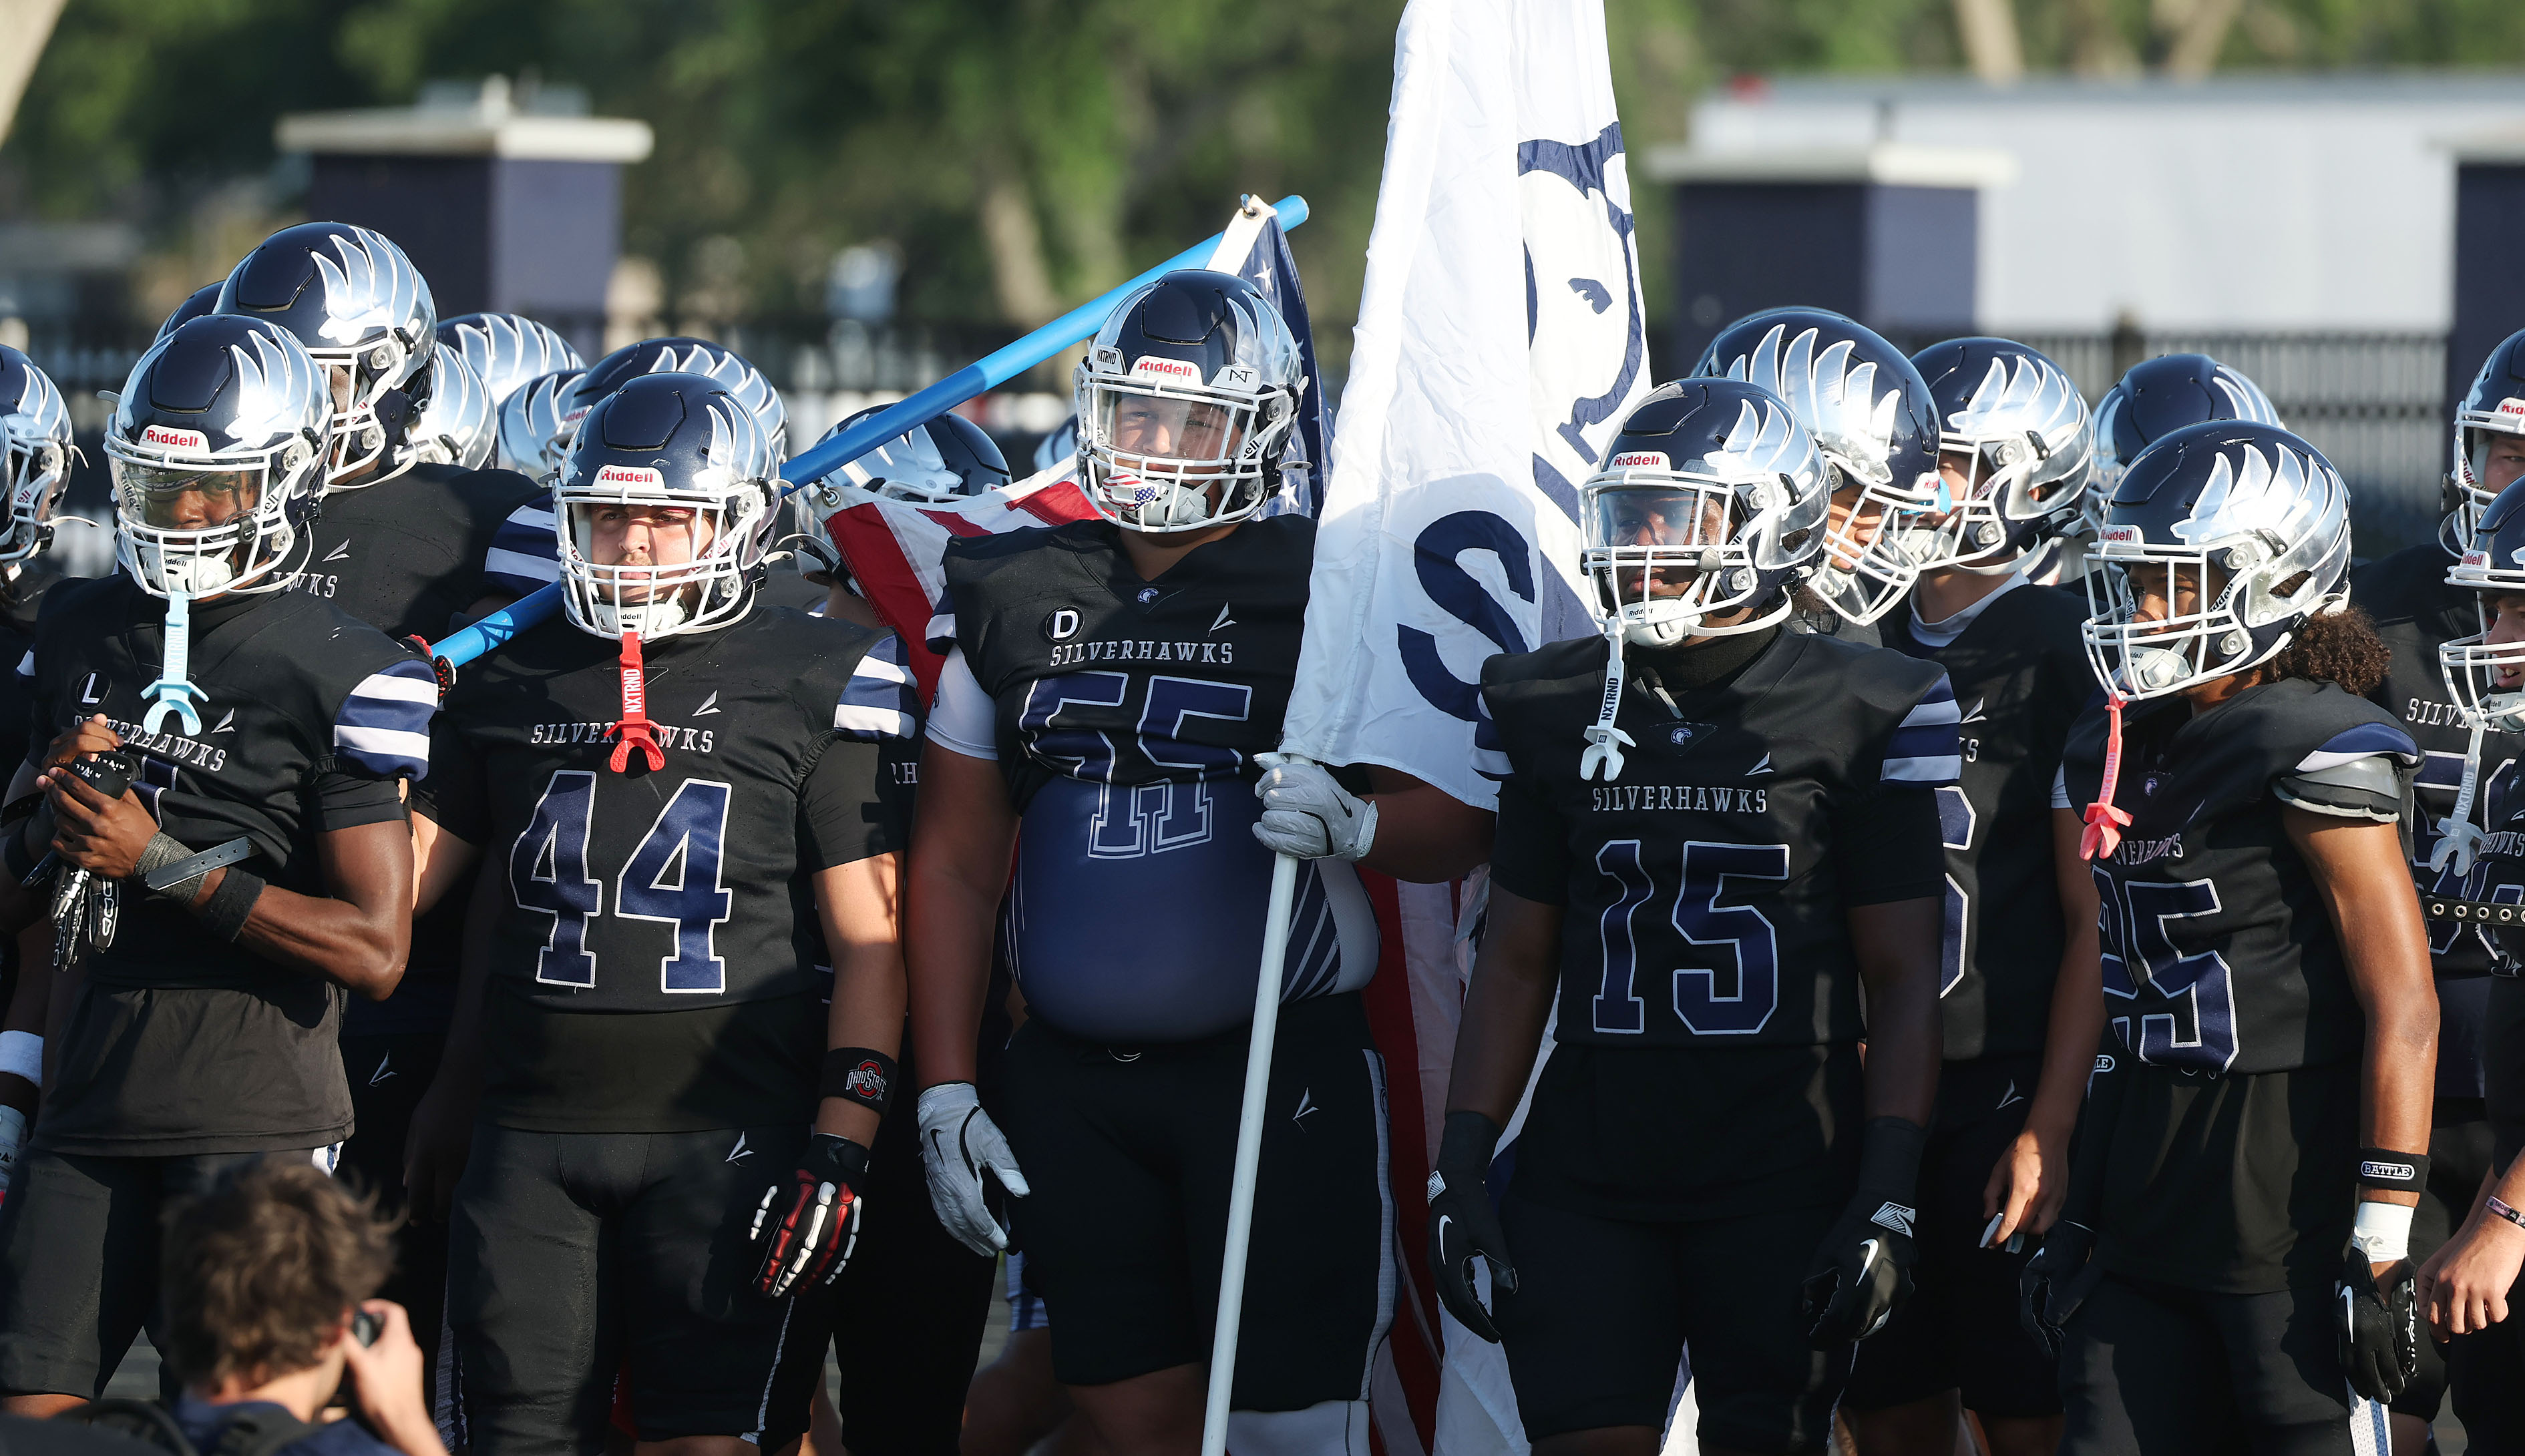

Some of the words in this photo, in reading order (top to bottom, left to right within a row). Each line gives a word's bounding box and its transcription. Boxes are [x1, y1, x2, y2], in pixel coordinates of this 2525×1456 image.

[1097, 349, 1117, 365] NXTRND
[1139, 361, 1193, 377] Riddell
[146, 429, 198, 447] Riddell
[1613, 455, 1660, 467] Riddell
[601, 470, 653, 483] Riddell
[2100, 529, 2133, 541] Riddell
[1053, 610, 1079, 639] D
[1629, 608, 1654, 618] Riddll
[166, 628, 186, 673] NXTRND
[1050, 640, 1233, 667] SILVERHAWKS
[81, 672, 100, 704] L
[622, 668, 642, 713] NXTRND
[1601, 677, 1619, 720] NXTRND
[530, 722, 715, 754] SILVERWKS
[1592, 785, 1767, 814] SILVERHAWKS
[2455, 772, 2475, 815] NXTRND
[509, 770, 733, 994] 44
[1593, 839, 1790, 1035] 15
[2364, 1164, 2410, 1177] BATTLE
